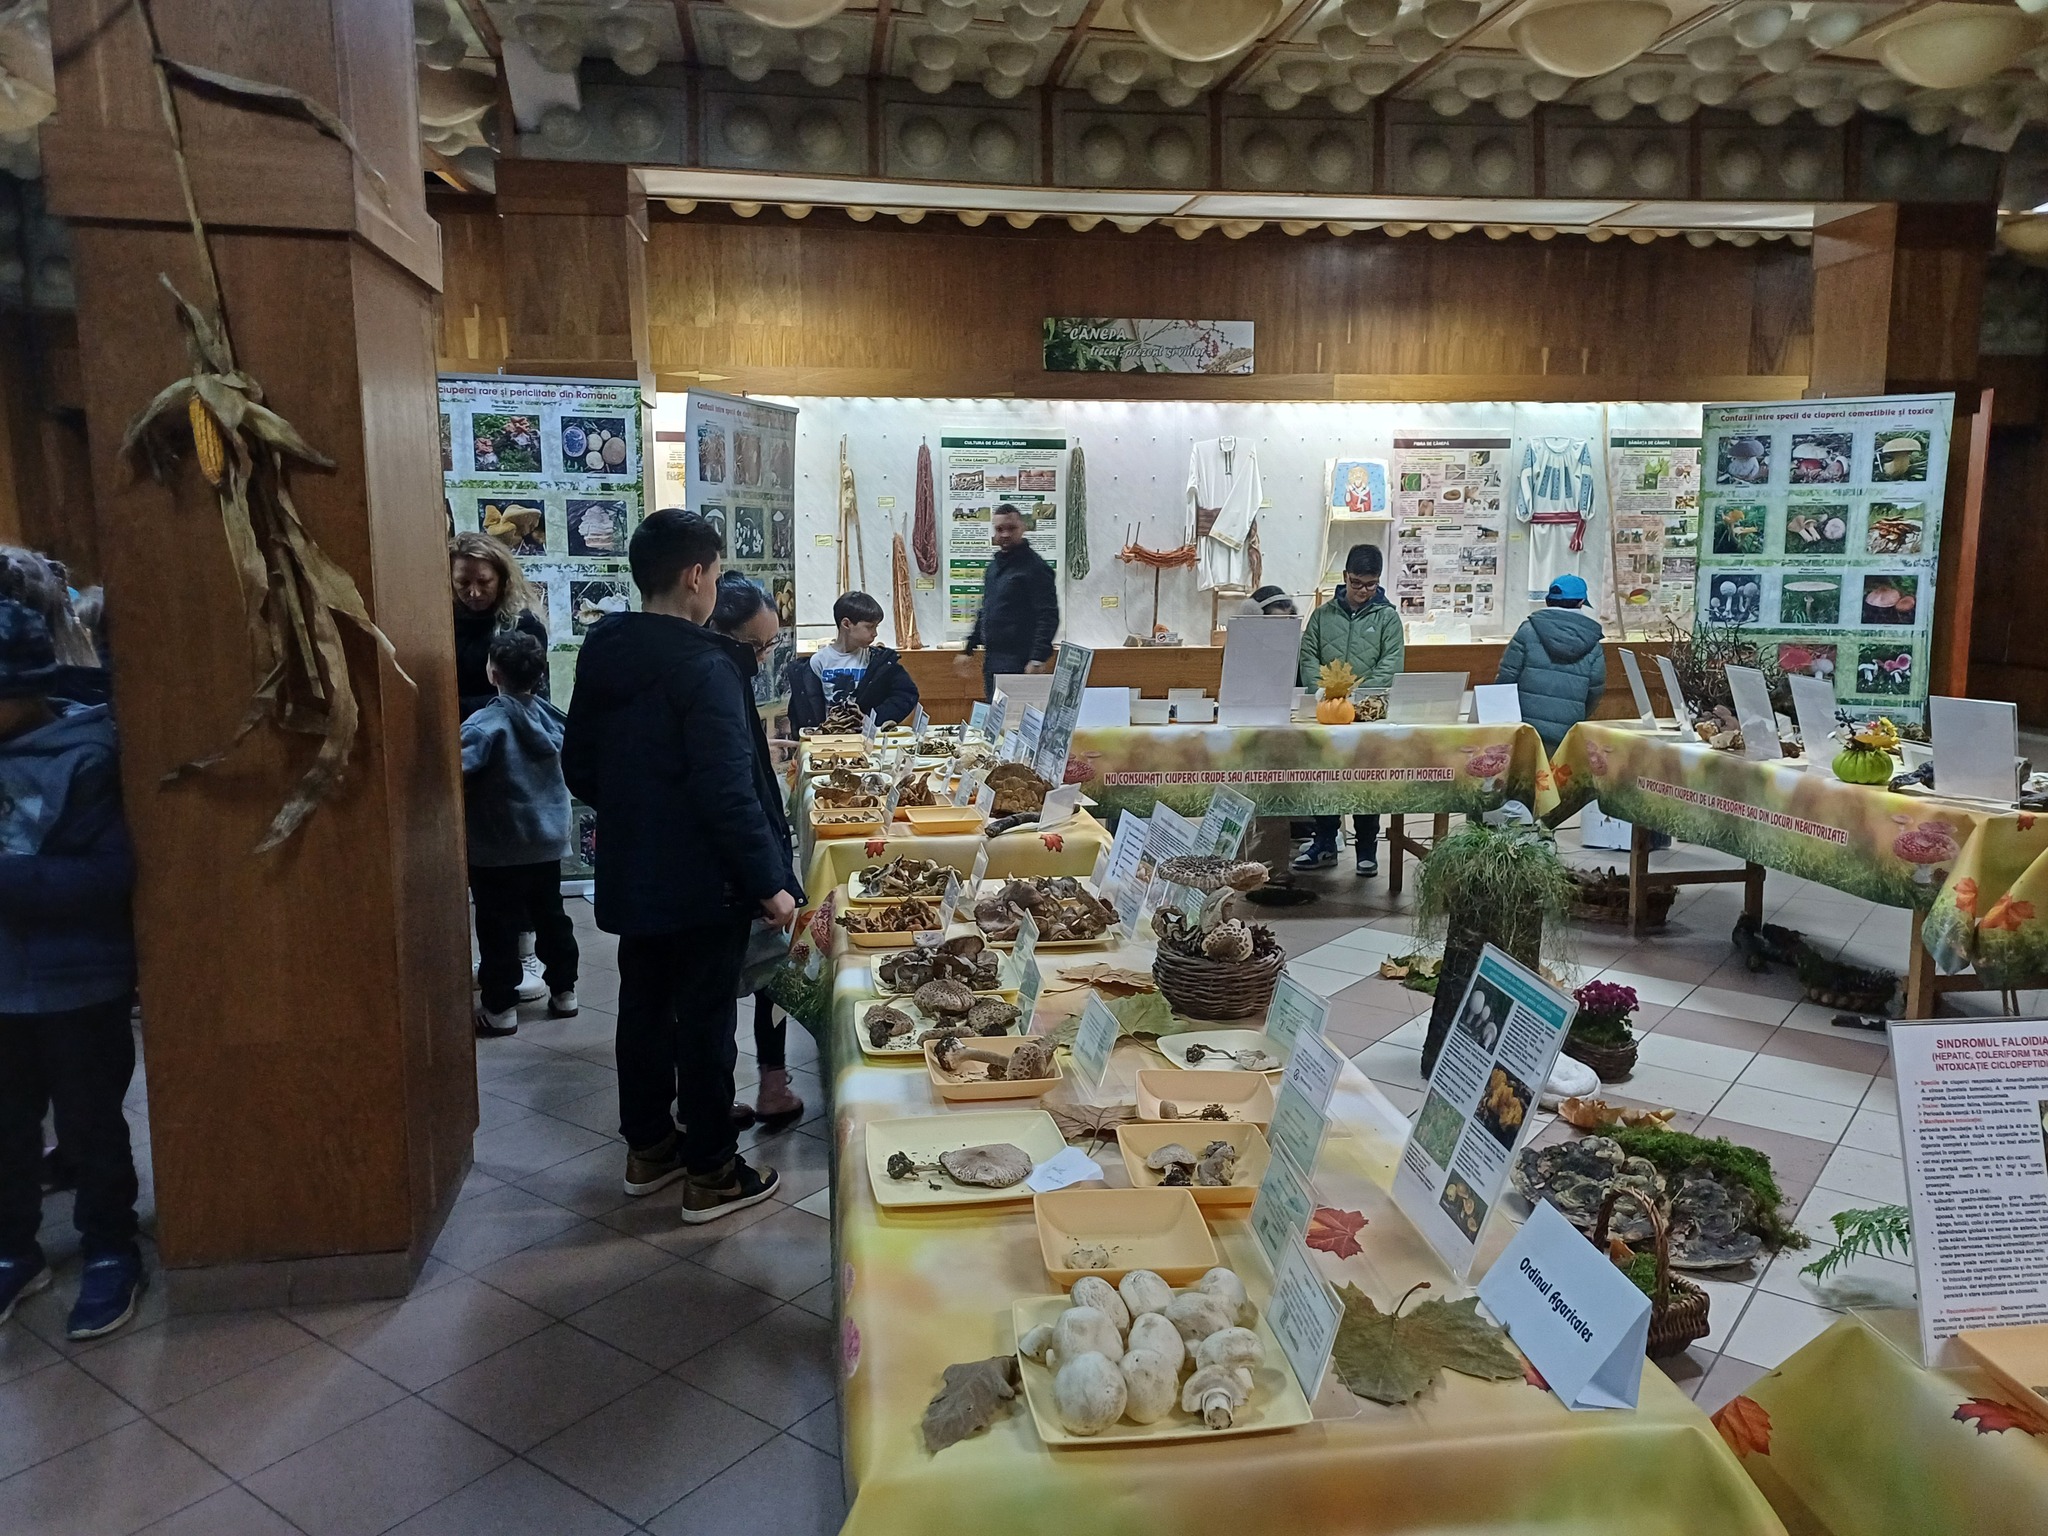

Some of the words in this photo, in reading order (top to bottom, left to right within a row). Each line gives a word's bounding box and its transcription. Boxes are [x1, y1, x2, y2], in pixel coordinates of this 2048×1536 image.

[438, 387, 476, 397] ciuperci
[478, 388, 498, 396] rare
[509, 389, 557, 400] periclitate
[559, 390, 574, 399] din
[1776, 412, 1799, 422] specii
[1814, 411, 1846, 420] ciuperci
[1848, 408, 1896, 418] comestibile
[1908, 407, 1935, 416] toxice
[1105, 773, 1117, 785] NU
[1118, 773, 1163, 787] CONSUMAȚI
[1165, 772, 1199, 784] CIUPERCI
[1201, 772, 1226, 783] CRUDE
[1227, 771, 1242, 783] SAU
[1342, 770, 1352, 781] CU
[1354, 769, 1387, 781] CIUPERCI
[1389, 769, 1405, 780] POT
[1406, 769, 1414, 780] FI
[1637, 778, 1645, 789] NU
[1674, 786, 1698, 804] CIUPERCI
[1699, 793, 1707, 805] DE
[1708, 795, 1716, 807] LA
[1716, 798, 1746, 816] PERSOANE
[1746, 806, 1758, 820] SAU
[1759, 809, 1770, 822] DIN
[1770, 813, 1793, 830] LOCURI
[1936, 1038, 2000, 1049] SINDROMUL
[1932, 1052, 1974, 1062] (HEPATIC,
[1975, 1050, 2030, 1059] COLERIFORM
[1935, 1061, 1989, 1072] INTOXICAȚIE
[1520, 1257, 1553, 1296] Ordinul
[1548, 1292, 1594, 1344] Agaricales
